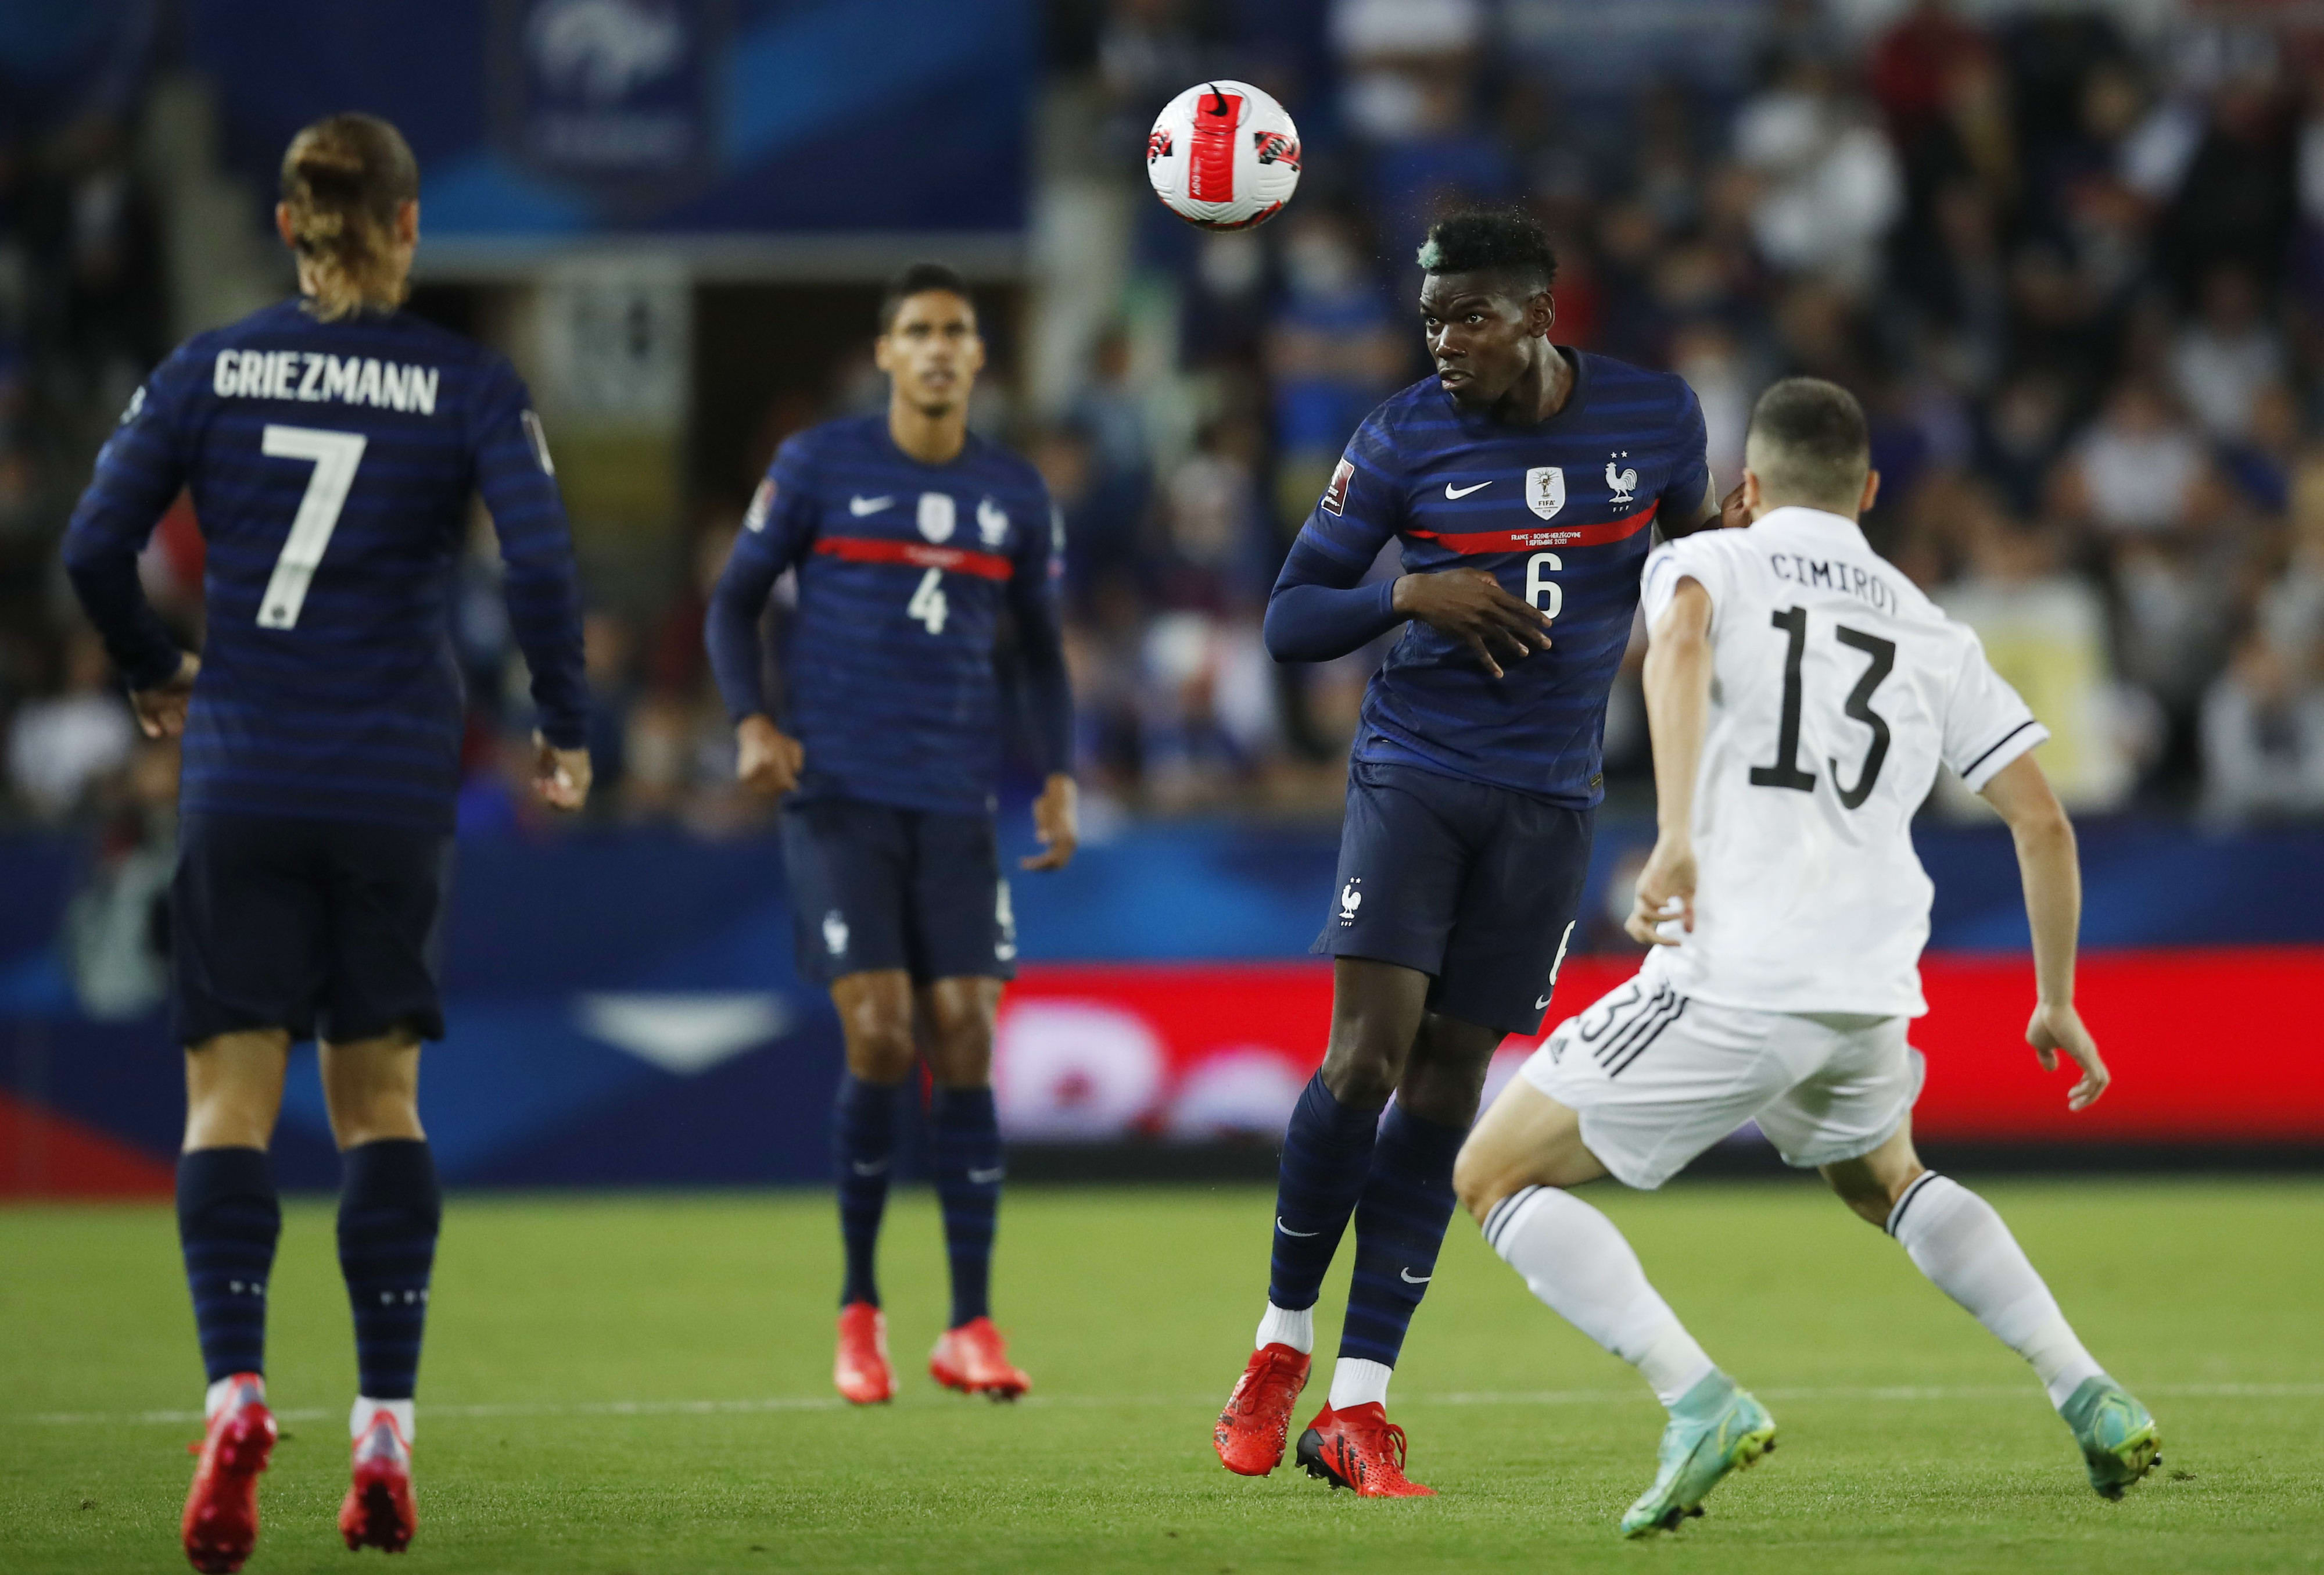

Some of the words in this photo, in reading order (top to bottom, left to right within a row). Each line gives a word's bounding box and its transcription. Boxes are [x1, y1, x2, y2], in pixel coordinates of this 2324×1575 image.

[213, 349, 439, 416] GRIEZMANN
[256, 424, 368, 629] 7
[907, 567, 948, 635] 4
[1525, 552, 1563, 620] 6
[1749, 606, 1896, 810] 13
